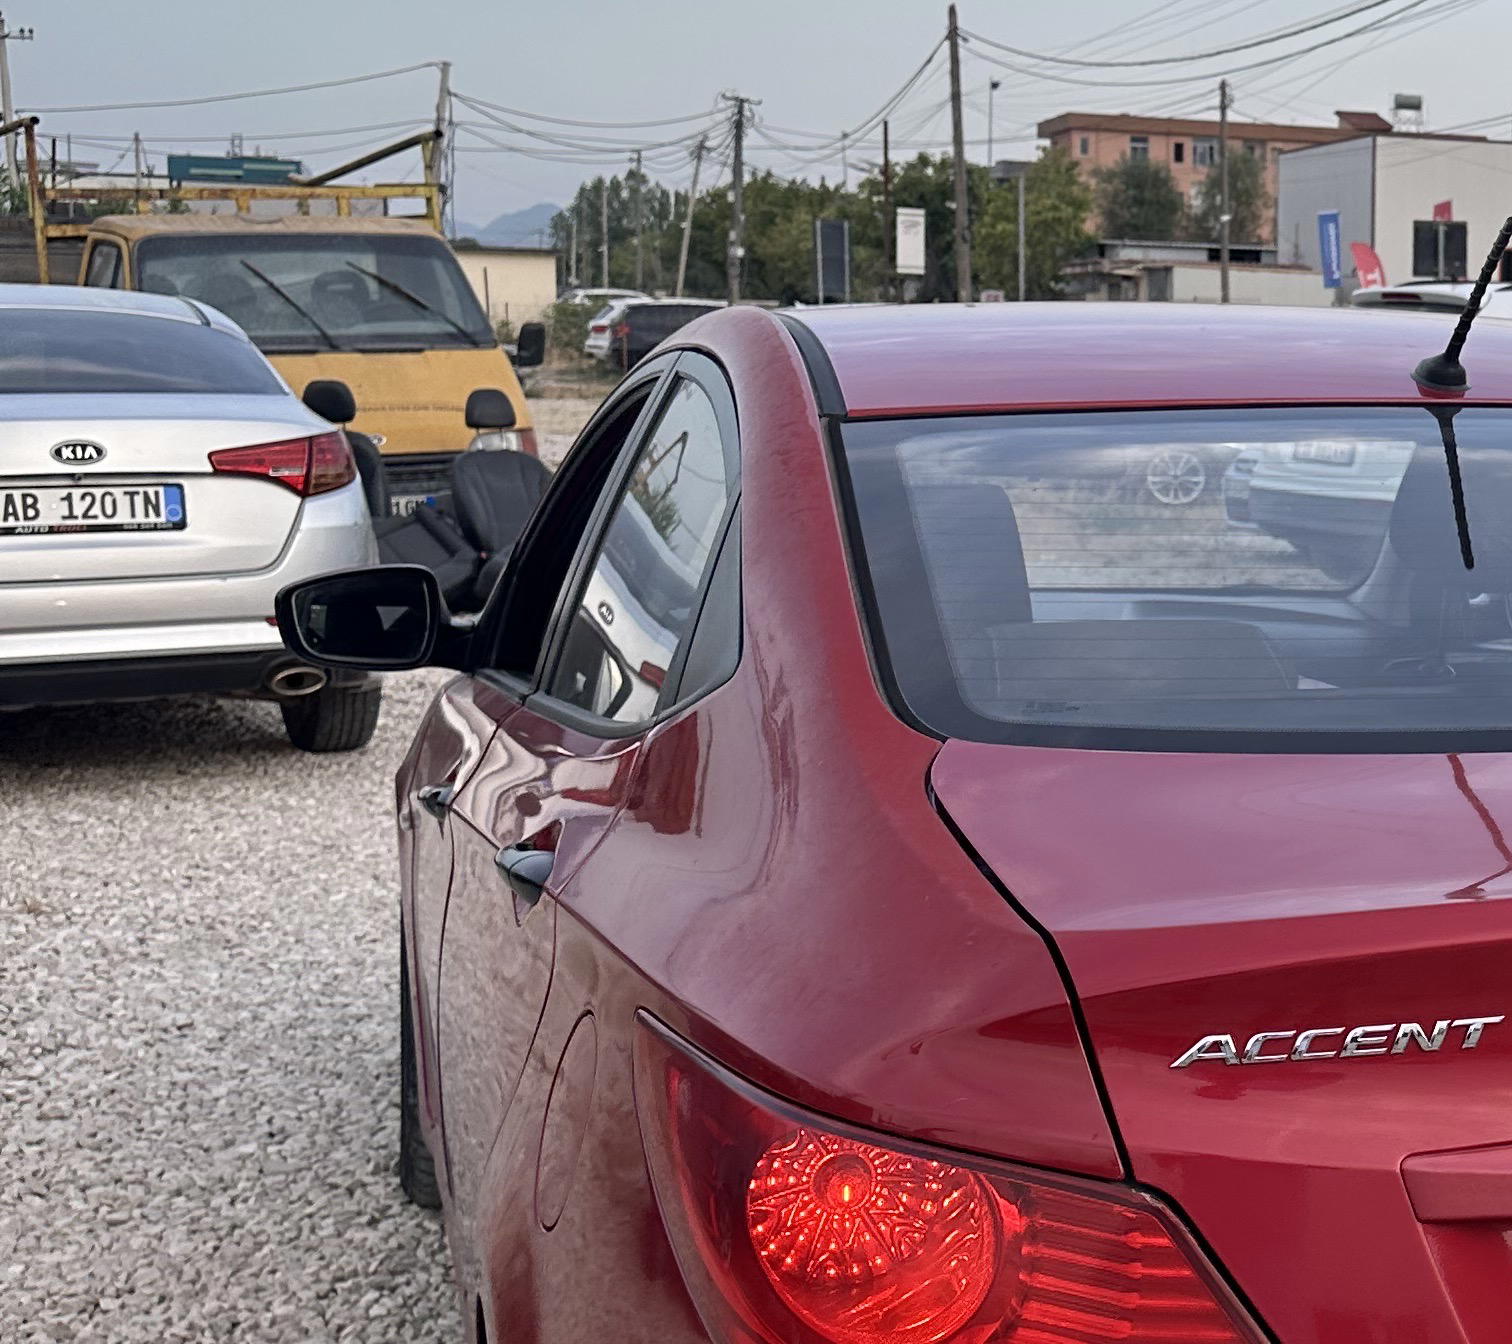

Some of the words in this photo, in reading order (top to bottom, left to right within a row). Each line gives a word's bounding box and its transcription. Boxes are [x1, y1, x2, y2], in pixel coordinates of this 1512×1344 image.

[60, 445, 98, 460] KIA
[3, 493, 40, 522] AB
[1169, 1015, 1505, 1068] ACCENT
